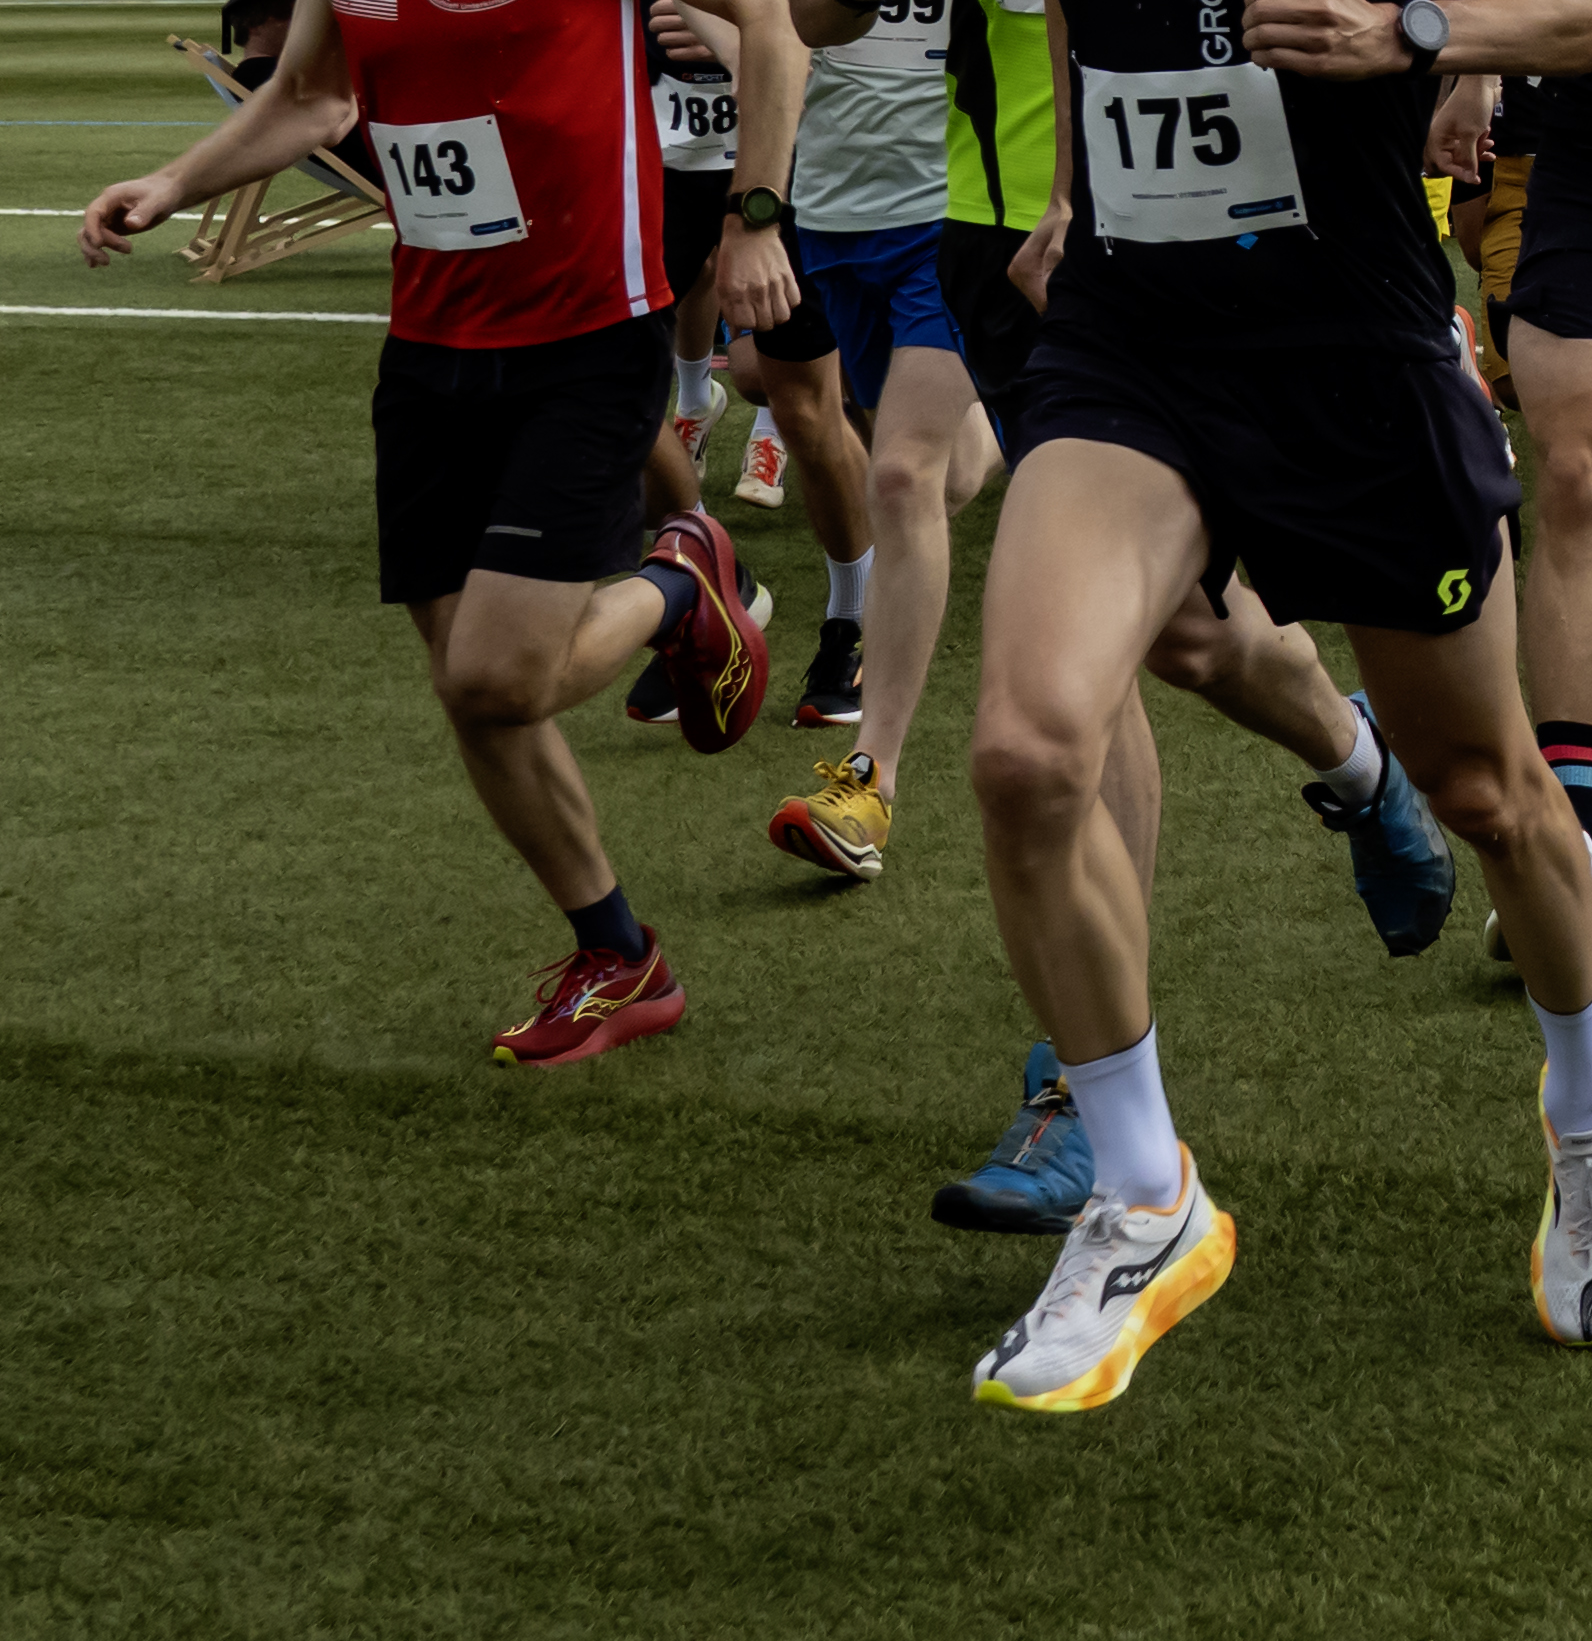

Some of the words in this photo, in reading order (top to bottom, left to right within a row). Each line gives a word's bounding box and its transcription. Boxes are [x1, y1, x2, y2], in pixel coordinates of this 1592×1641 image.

[669, 92, 738, 137] 188
[1104, 93, 1241, 169] 175
[389, 140, 475, 196] 143
